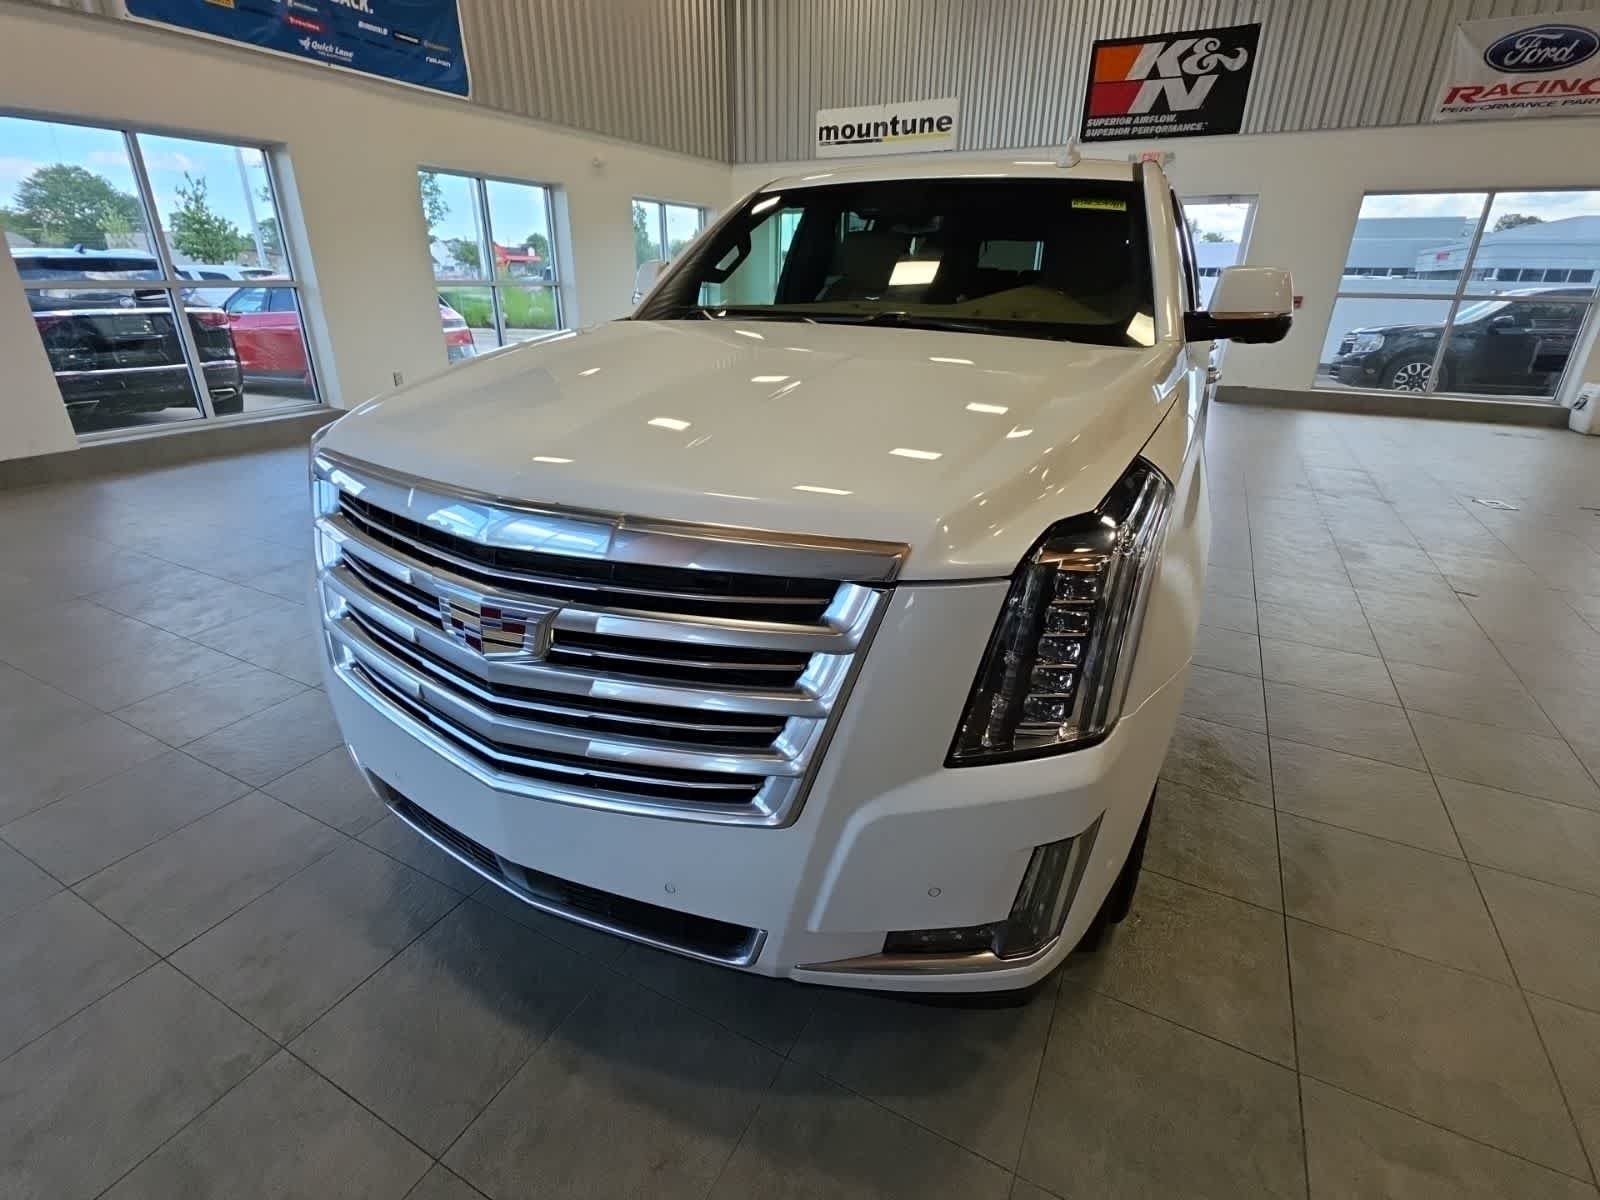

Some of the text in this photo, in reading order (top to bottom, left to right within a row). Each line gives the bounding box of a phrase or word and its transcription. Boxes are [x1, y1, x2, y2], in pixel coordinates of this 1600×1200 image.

[311, 39, 333, 53] Quick
[335, 46, 354, 58] Lane
[1503, 33, 1580, 66] Ford
[1440, 100, 1556, 113] PERFORMANCE
[818, 114, 953, 141] mountune
[1086, 114, 1177, 127] SUPERIOR AIRFLOW.
[1085, 127, 1131, 137] SUPERIOR
